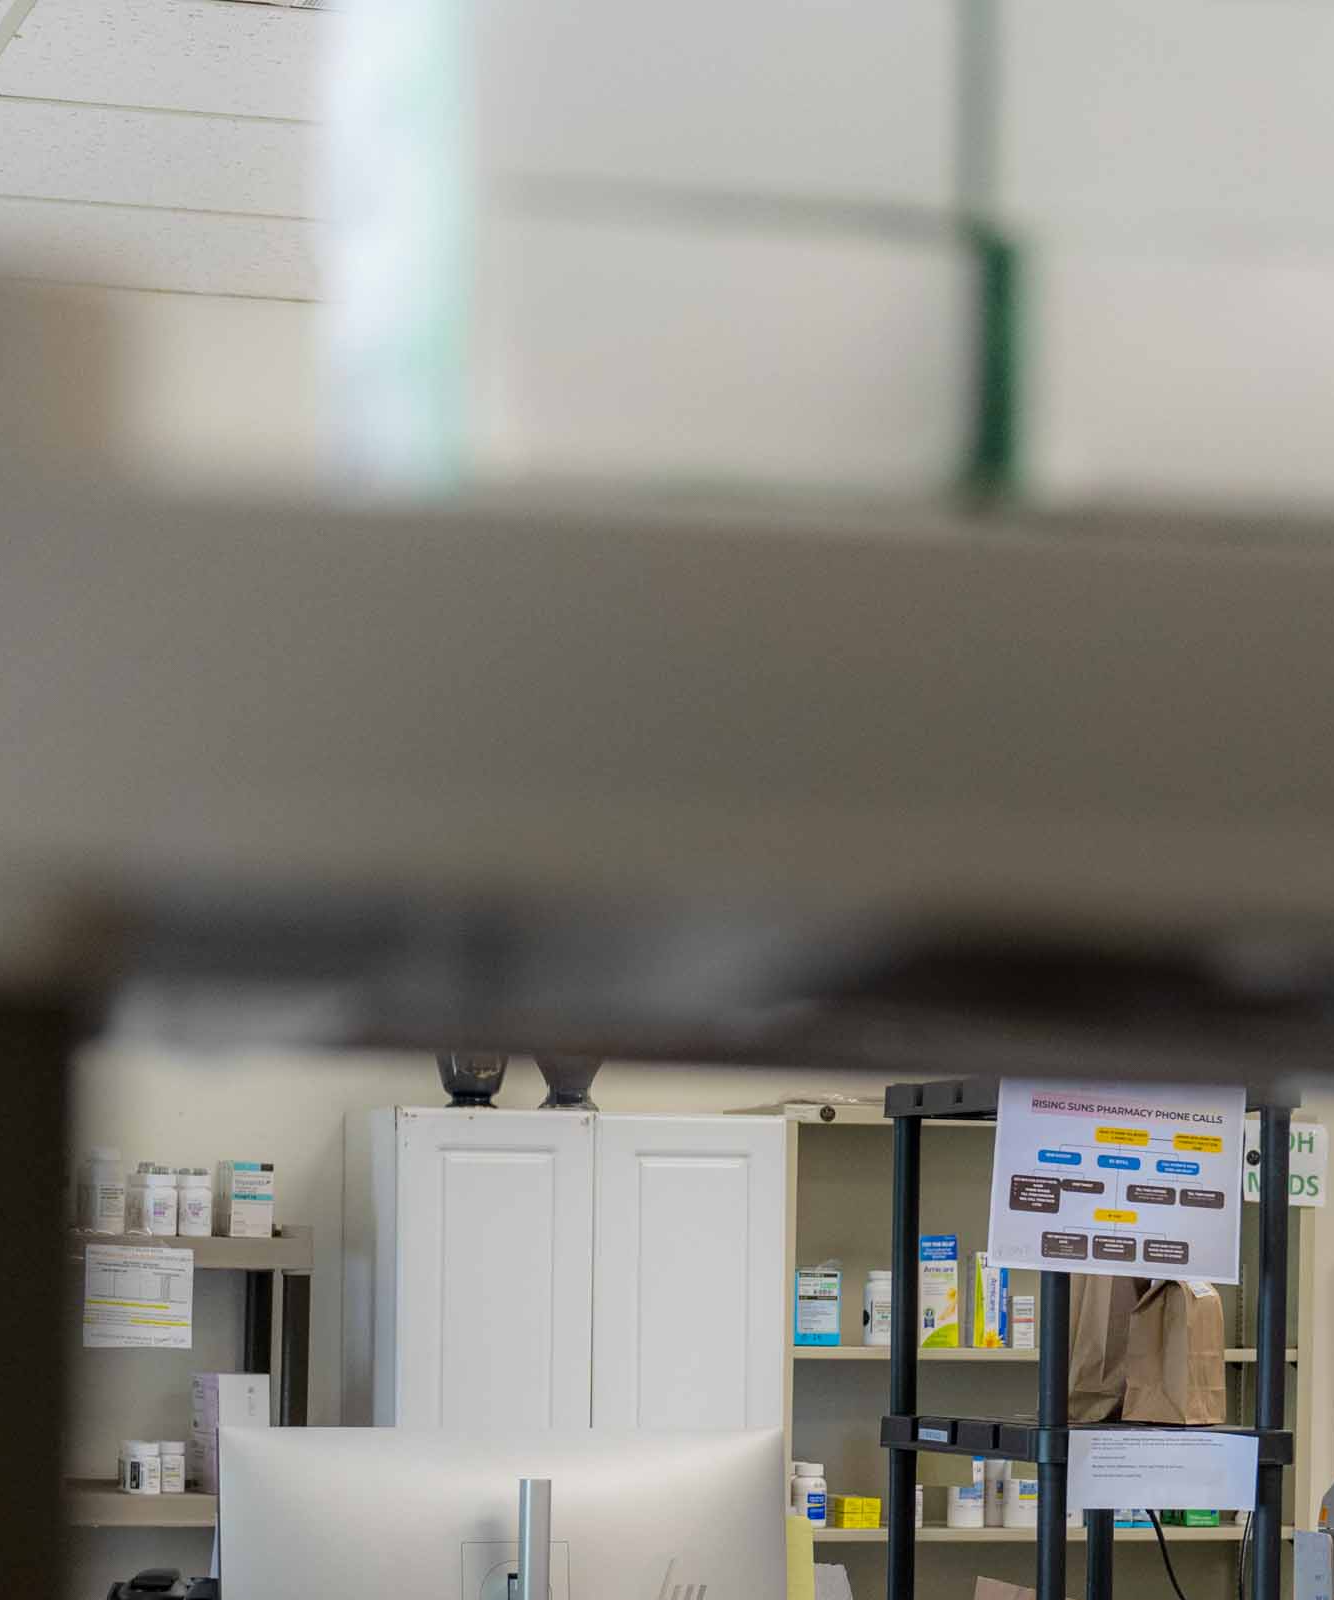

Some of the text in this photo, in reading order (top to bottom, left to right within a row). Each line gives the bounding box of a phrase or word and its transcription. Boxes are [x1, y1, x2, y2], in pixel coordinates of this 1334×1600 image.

[1031, 1099, 1223, 1125] RISING SUNS PHARMACY PHONE CALLS
